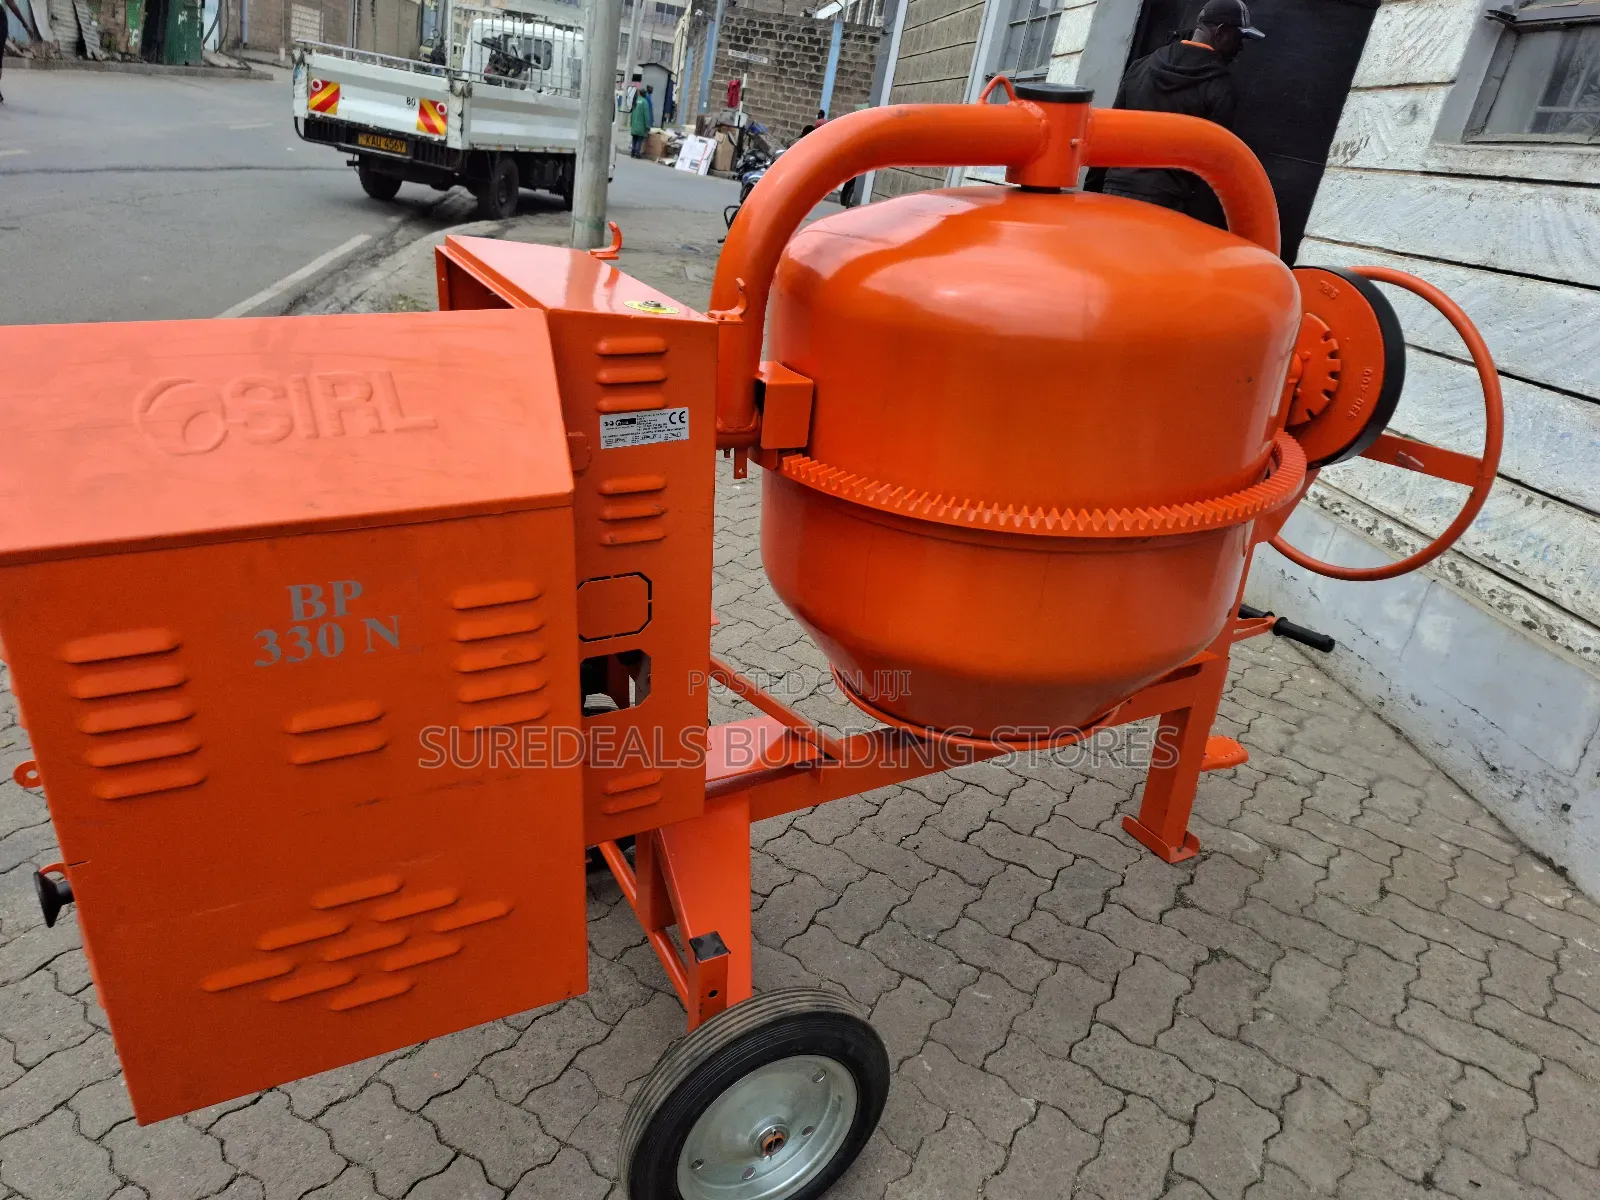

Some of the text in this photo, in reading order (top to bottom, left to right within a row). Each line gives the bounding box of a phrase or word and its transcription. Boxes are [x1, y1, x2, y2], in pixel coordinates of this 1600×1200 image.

[285, 580, 364, 622] BP
[253, 615, 401, 667] 330 N
